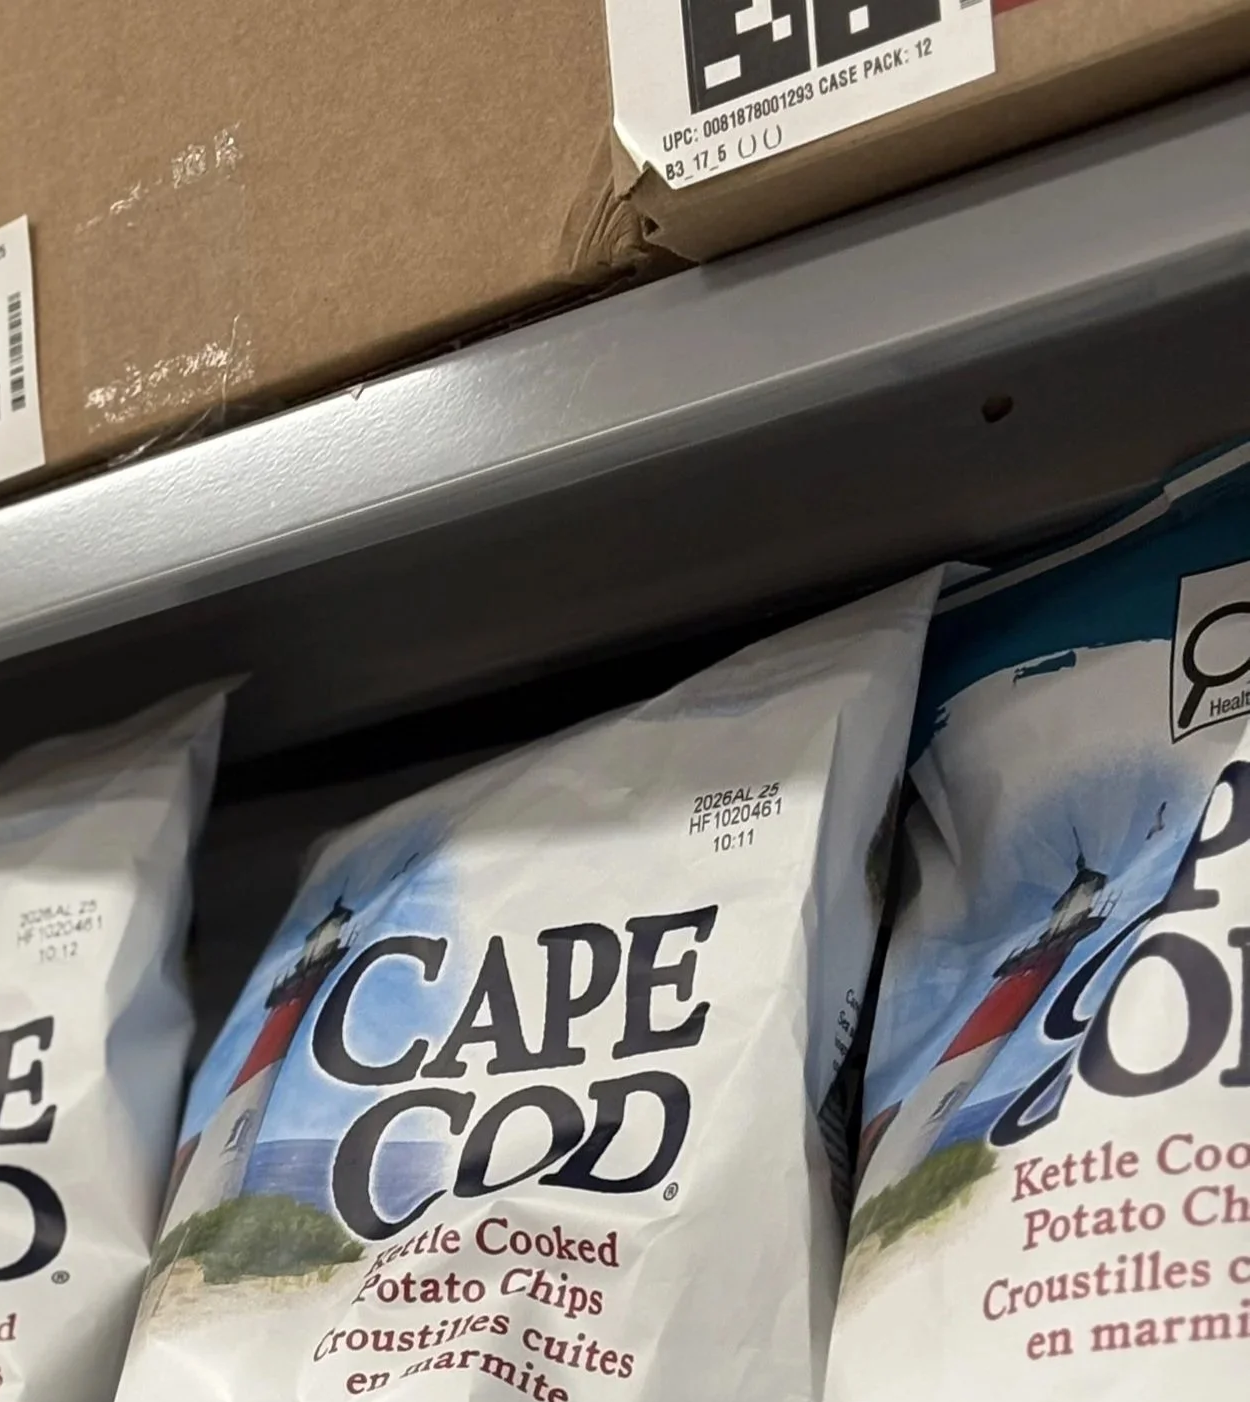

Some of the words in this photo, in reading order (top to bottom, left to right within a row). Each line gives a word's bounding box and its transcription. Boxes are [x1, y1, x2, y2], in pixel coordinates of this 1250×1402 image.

[662, 127, 699, 151] UPC:
[703, 83, 814, 138] 0081878001293
[818, 65, 858, 95] CASE
[863, 47, 910, 79] PACK:
[914, 37, 933, 58] 12
[693, 787, 753, 814] 2026AL
[757, 781, 780, 799] 25
[713, 828, 754, 852] 10:11
[311, 904, 718, 1087] CAPE
[330, 1070, 692, 1241] COD
[1011, 1140, 1140, 1203] Kettle
[365, 1223, 461, 1277] Kettle
[475, 1217, 620, 1268] Cooked
[1022, 1197, 1166, 1251] Potato
[352, 1271, 486, 1305] Potato
[500, 1268, 604, 1319] Chips
[982, 1250, 1212, 1322] Croustilles
[313, 1313, 511, 1363] Croustilles
[521, 1327, 635, 1380] cuites
[1026, 1326, 1073, 1361] en
[345, 1370, 391, 1395] en
